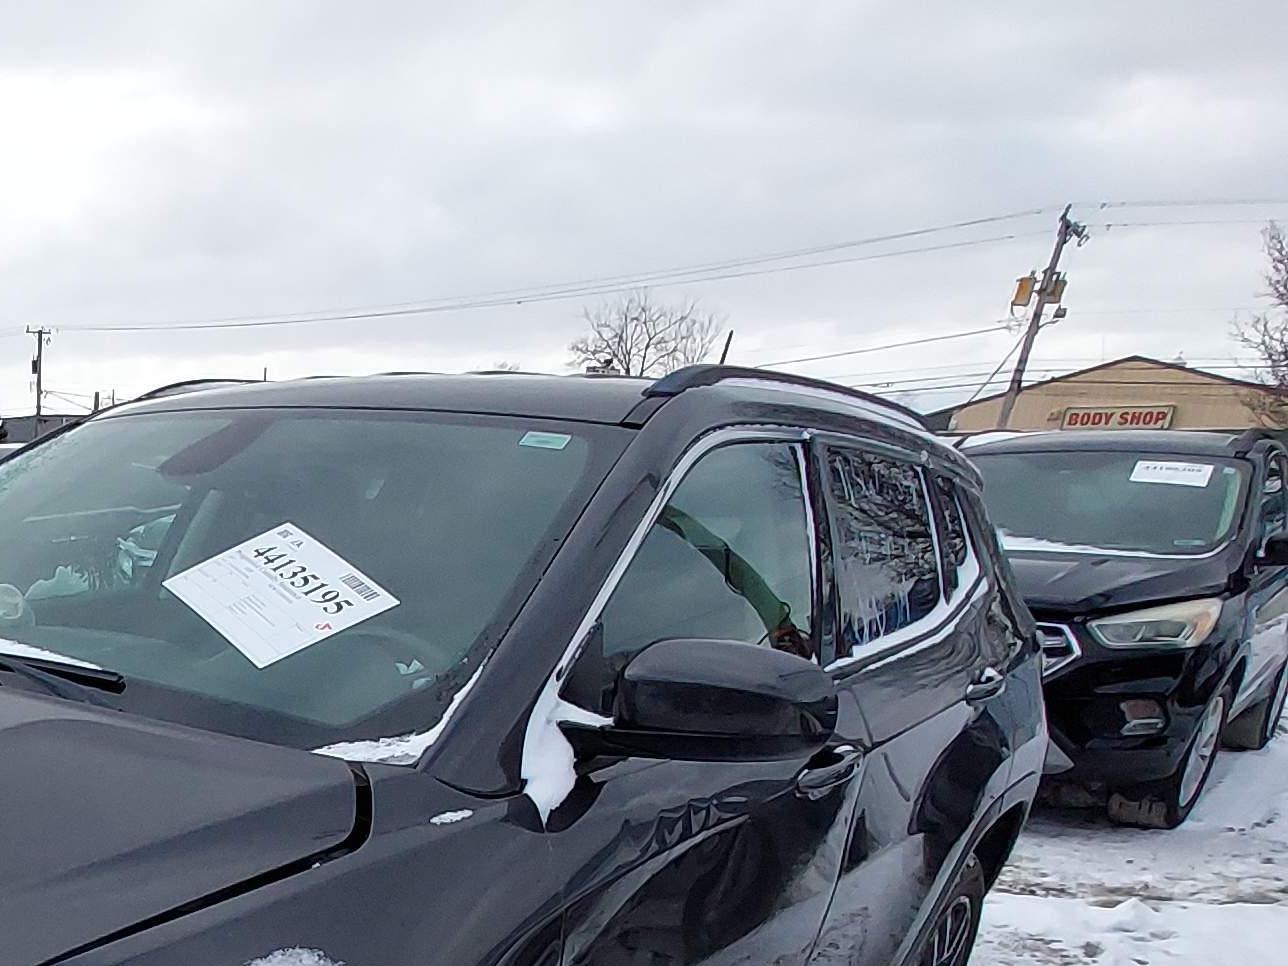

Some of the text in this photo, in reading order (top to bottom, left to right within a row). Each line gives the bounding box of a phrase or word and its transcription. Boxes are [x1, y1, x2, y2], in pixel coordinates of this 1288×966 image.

[1067, 410, 1168, 426] BODY SHOP
[253, 546, 355, 615] 44135195
